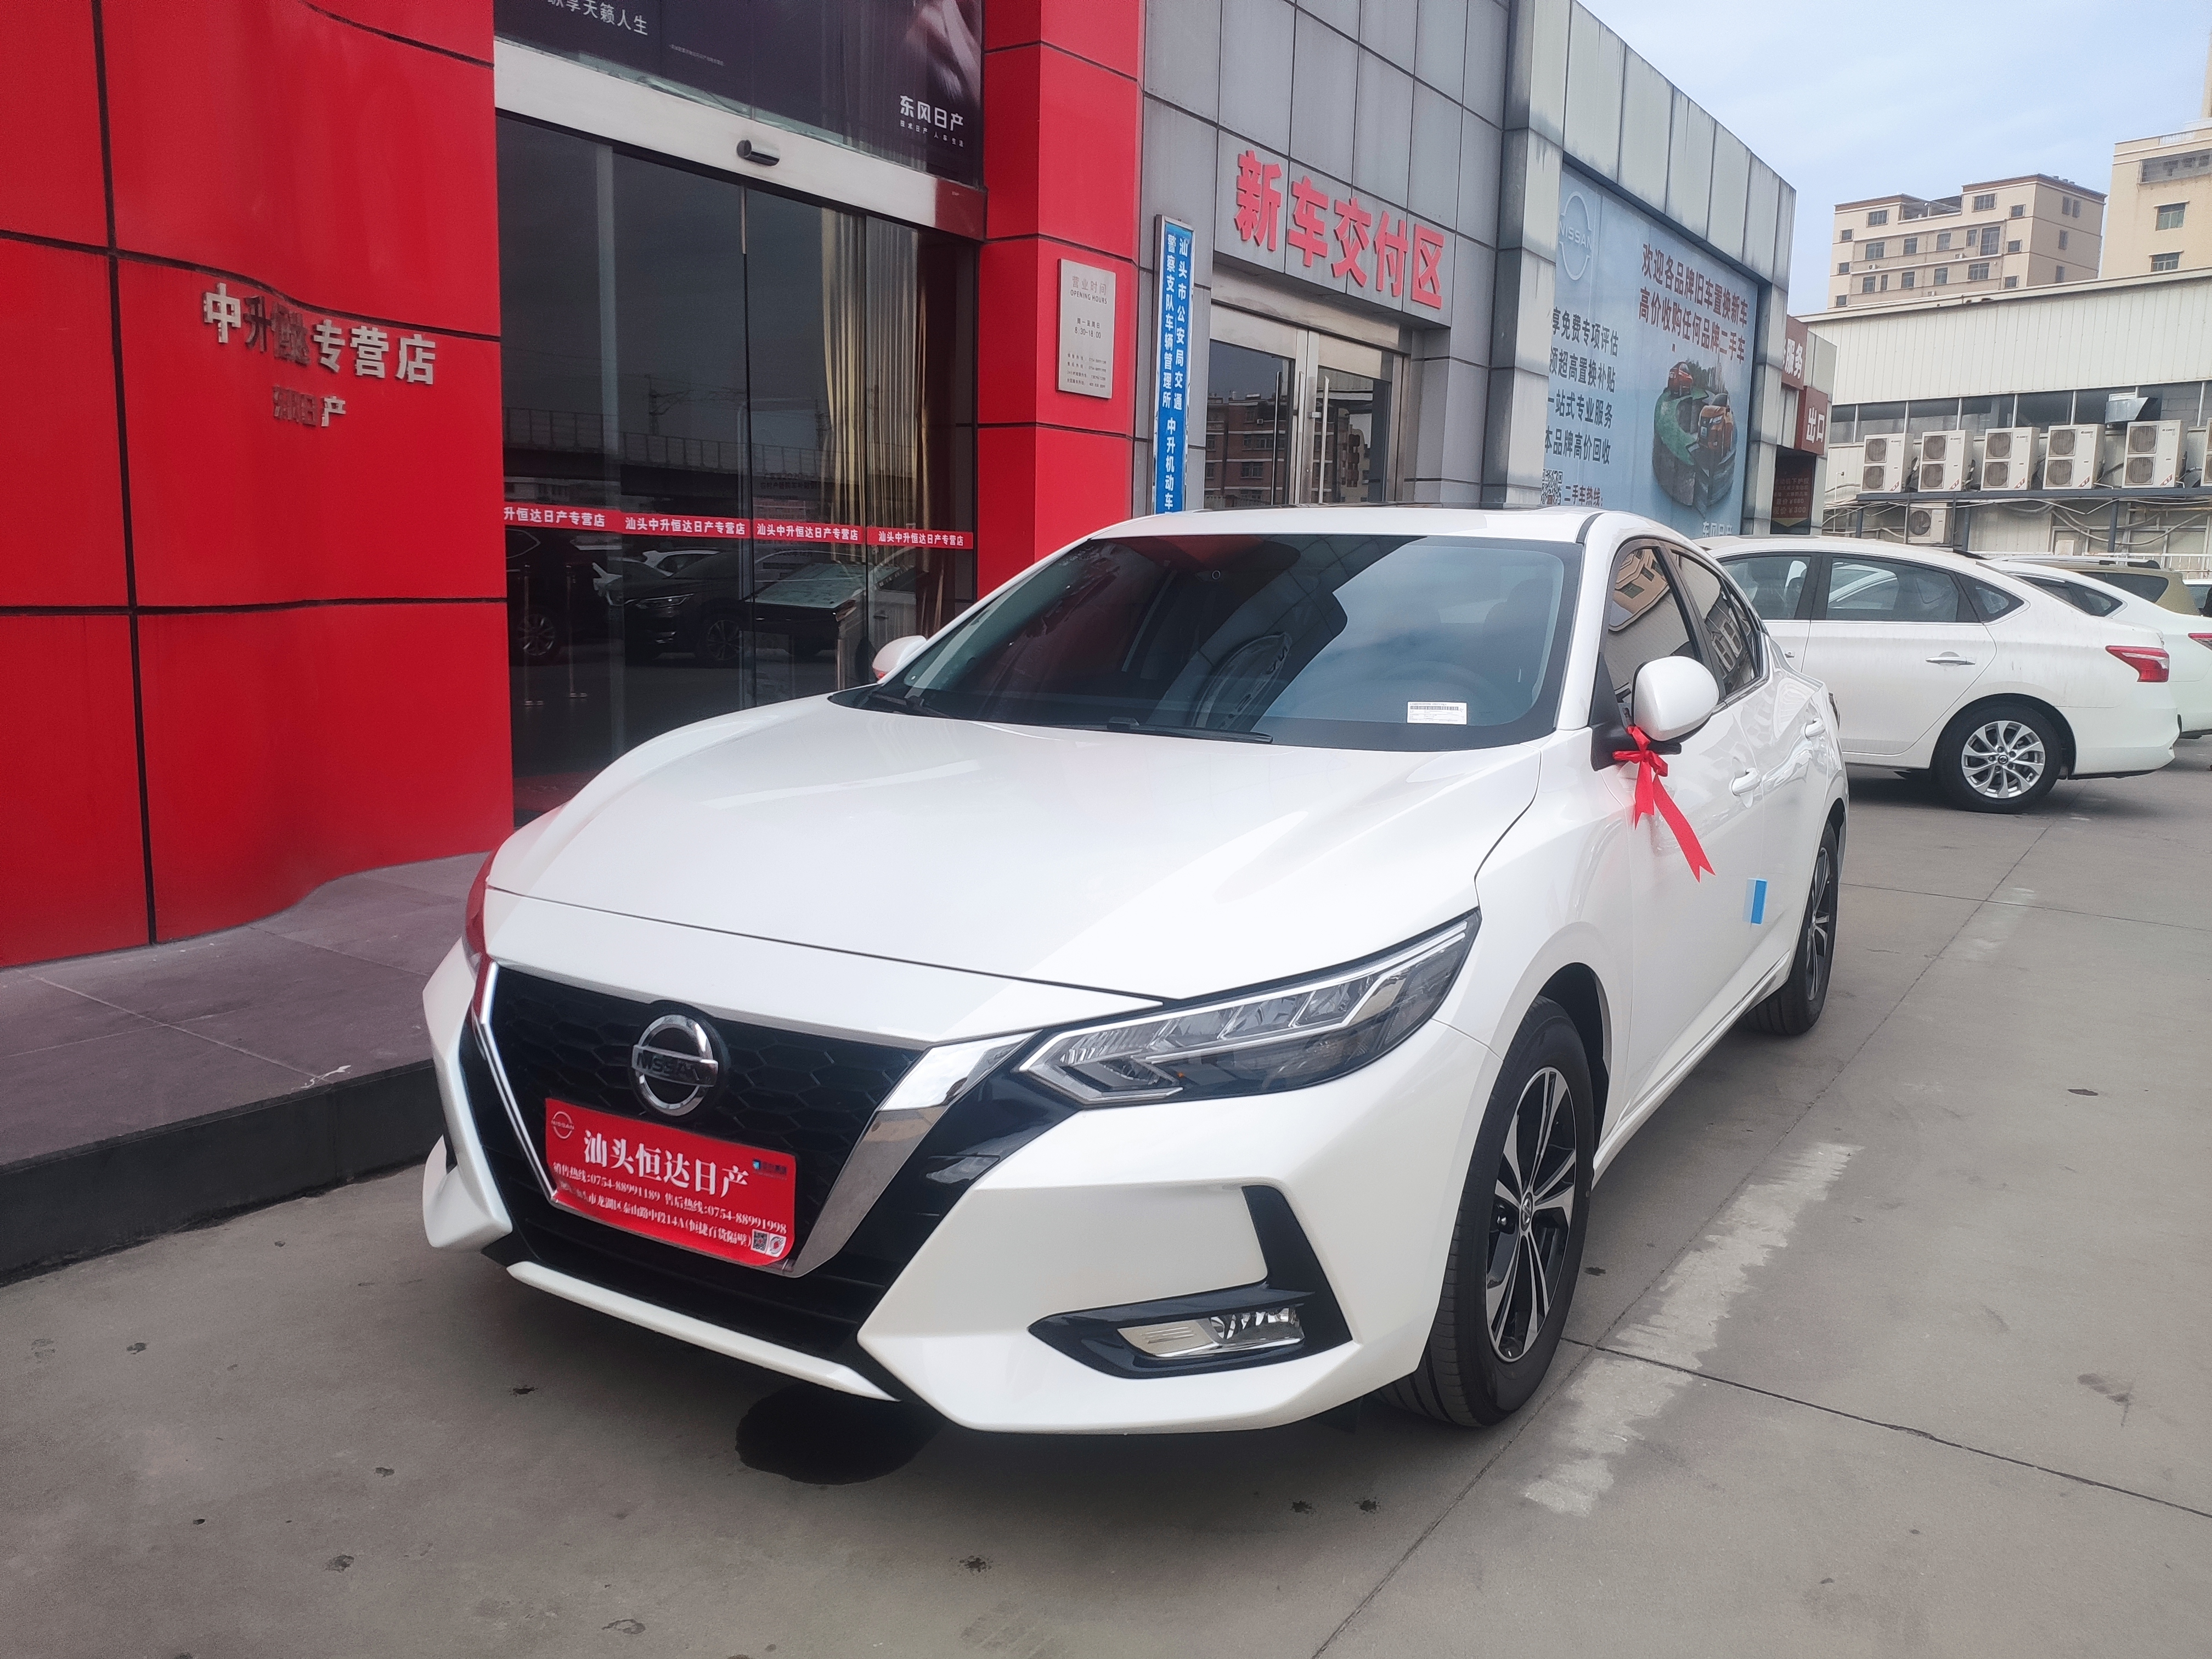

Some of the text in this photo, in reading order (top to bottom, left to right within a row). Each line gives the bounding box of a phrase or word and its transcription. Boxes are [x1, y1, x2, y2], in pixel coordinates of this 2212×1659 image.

[900, 95, 963, 131] 东风日产
[1234, 149, 1445, 309] 新车交付区
[1559, 221, 1592, 251] NISSAN
[1070, 290, 1107, 304] OPENING HOURS
[1072, 276, 1107, 296] 营业时间
[1641, 243, 1748, 328] 欢迎各品牌旧车置换新车
[1076, 318, 1100, 329] 周一至周日
[1173, 238, 1189, 410] 汕头市公安局交通
[1639, 286, 1745, 364] 高价收购任何品牌二手车
[1547, 388, 1613, 429] 一站式专业服务
[1806, 407, 1825, 443] 出口
[1544, 425, 1611, 465] 本品牌高价回收
[1164, 417, 1177, 514] 中升机动车
[504, 507, 605, 527] 升恒达日产专营店
[625, 517, 746, 535] 汕头中升恒达日产专营店
[757, 523, 859, 541] 汕头中升恒达日产专营店
[878, 531, 964, 546] 汕头中升恒达日产专营店
[584, 1130, 749, 1198] 汕头恒达日产
